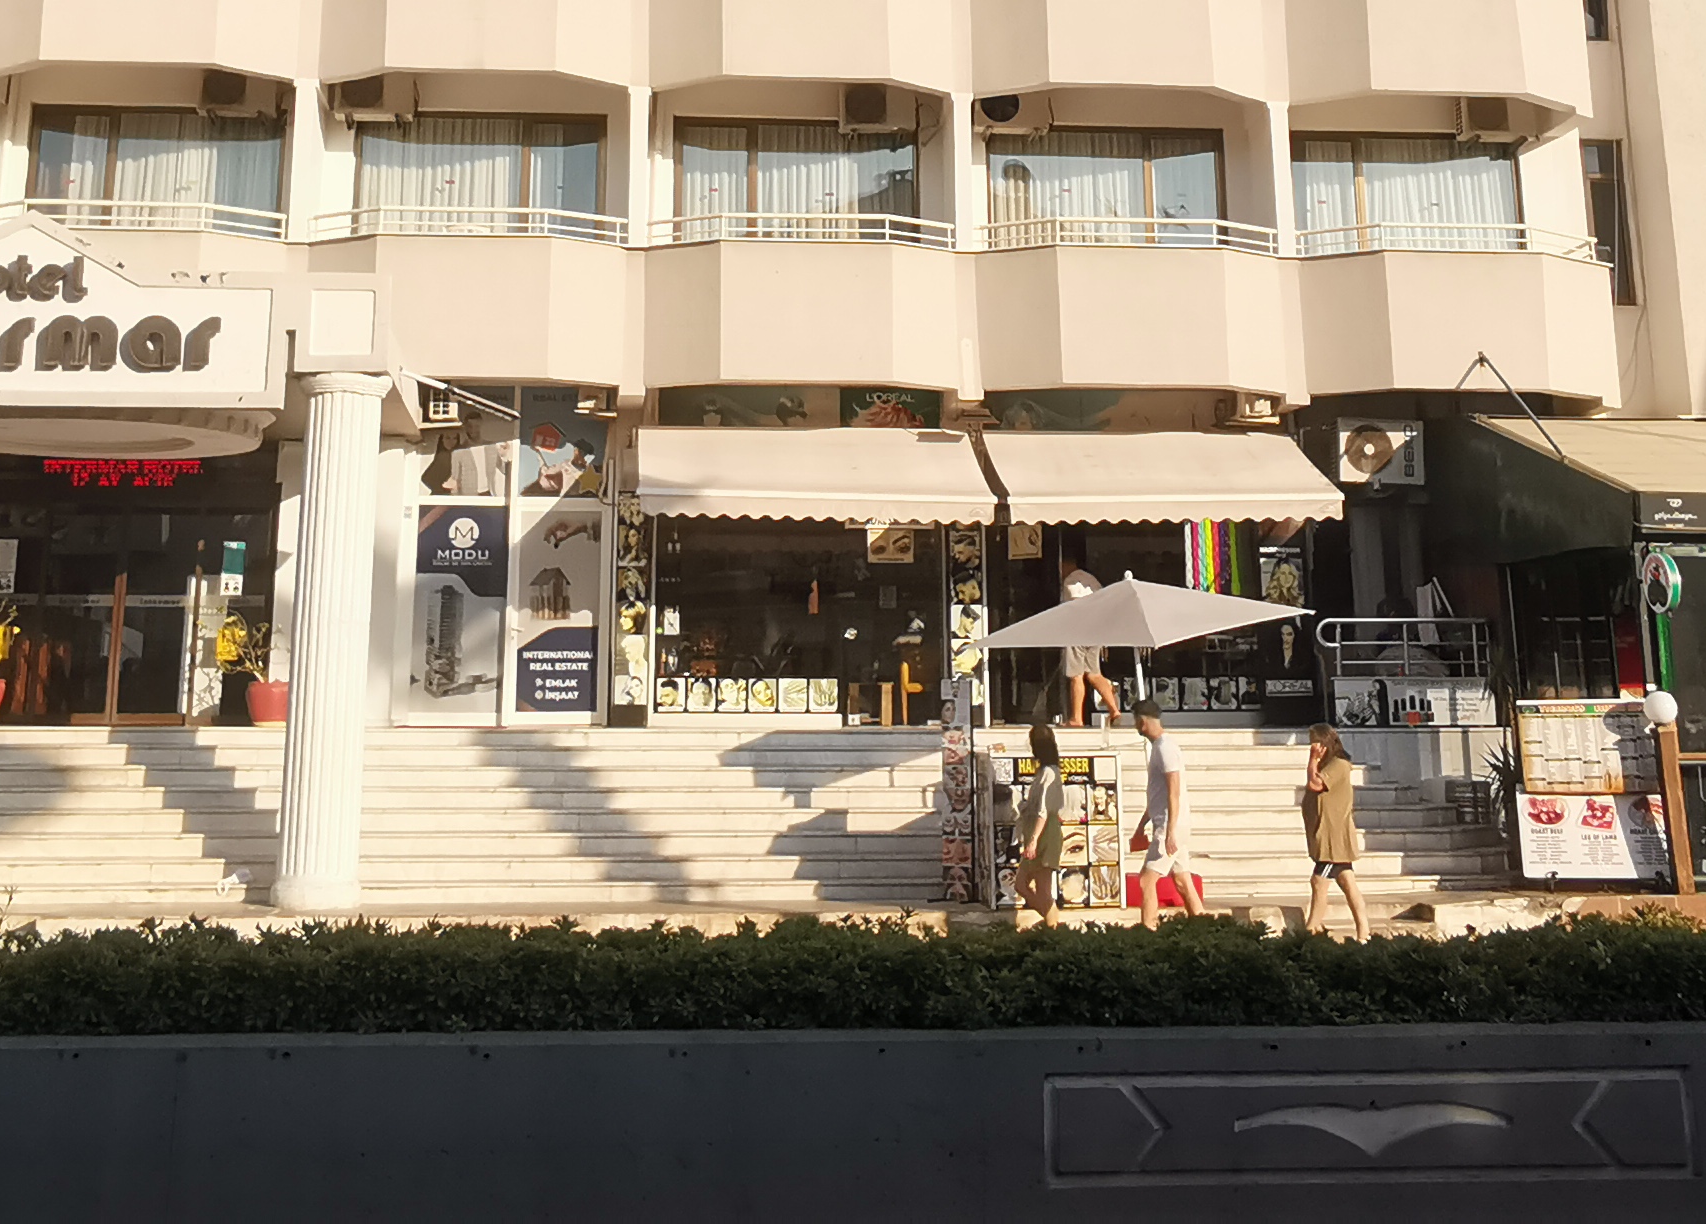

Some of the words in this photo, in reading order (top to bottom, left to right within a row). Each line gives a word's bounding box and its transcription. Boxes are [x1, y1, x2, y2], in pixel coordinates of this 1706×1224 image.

[522, 650, 593, 659] INTERNATIONA
[529, 662, 553, 671] REAL
[554, 662, 589, 671] ESTATE
[545, 678, 578, 687] EMLAK
